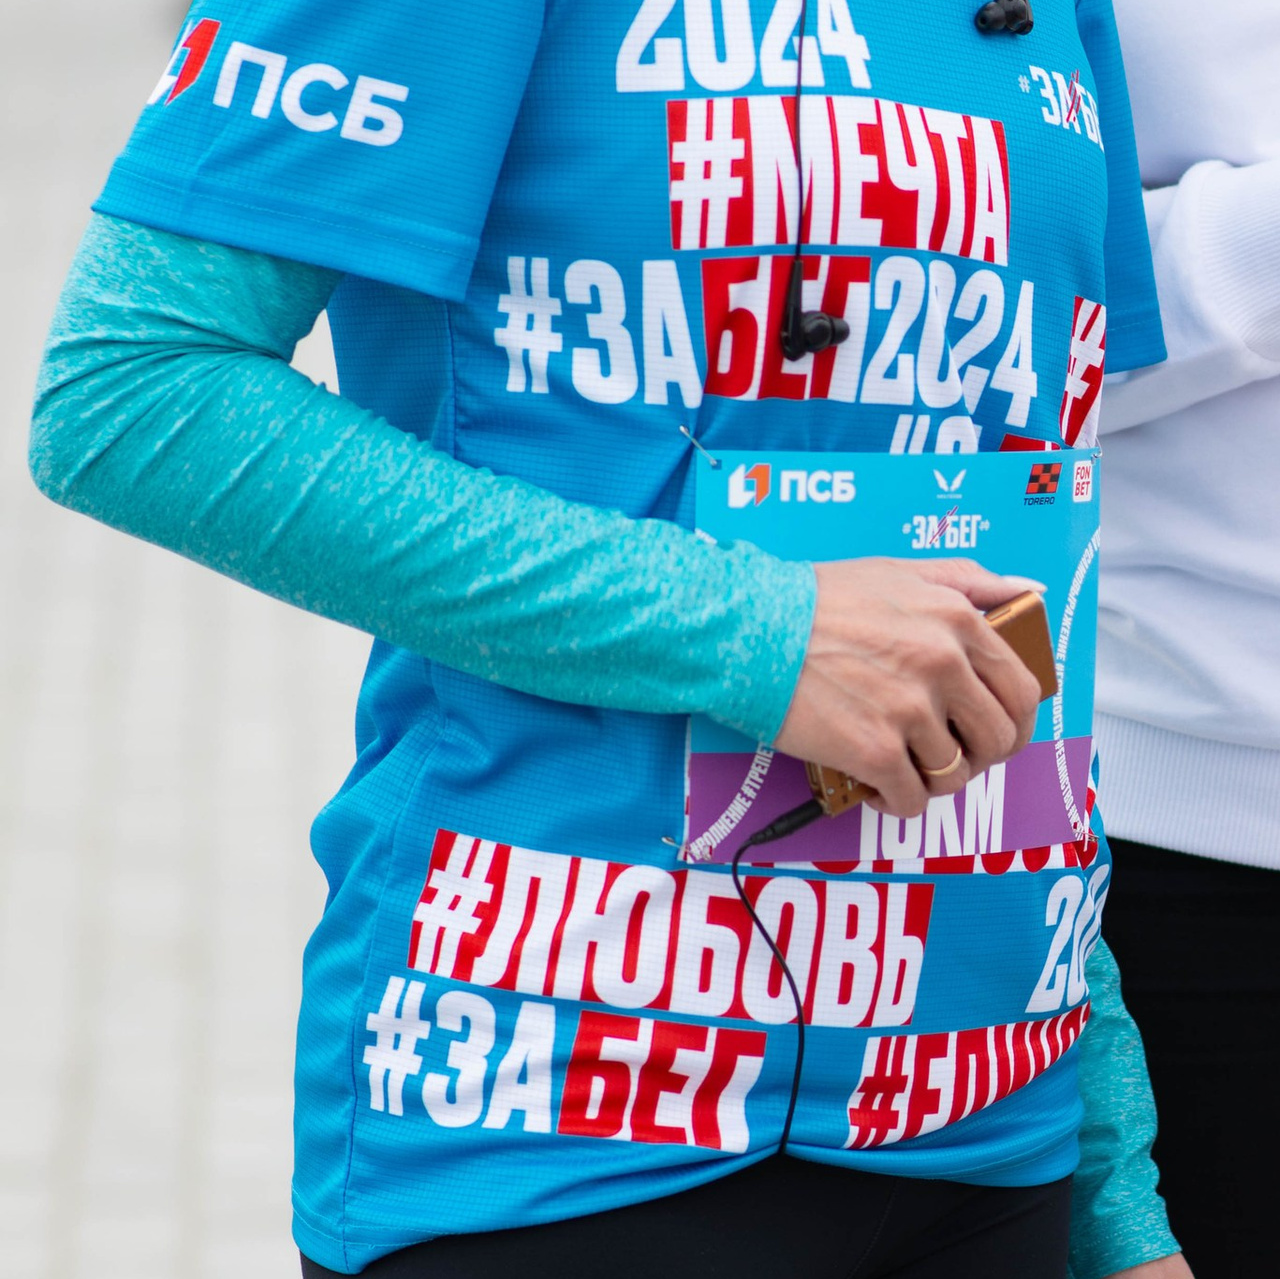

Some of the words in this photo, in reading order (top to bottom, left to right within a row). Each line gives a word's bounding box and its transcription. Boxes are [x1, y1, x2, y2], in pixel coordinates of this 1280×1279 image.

[212, 40, 410, 147] ПСБ
[668, 96, 1010, 266] #МЕЧТА
[779, 470, 856, 503] ПСБ
[1023, 496, 1056, 506] TORERO
[1075, 465, 1091, 480] FON
[1075, 481, 1091, 496] BET
[740, 740, 775, 800] #ТРЕПЕ
[410, 829, 928, 1027] #ЛЮБОВЬ
[362, 975, 768, 1152] #ЗАБЕГ
